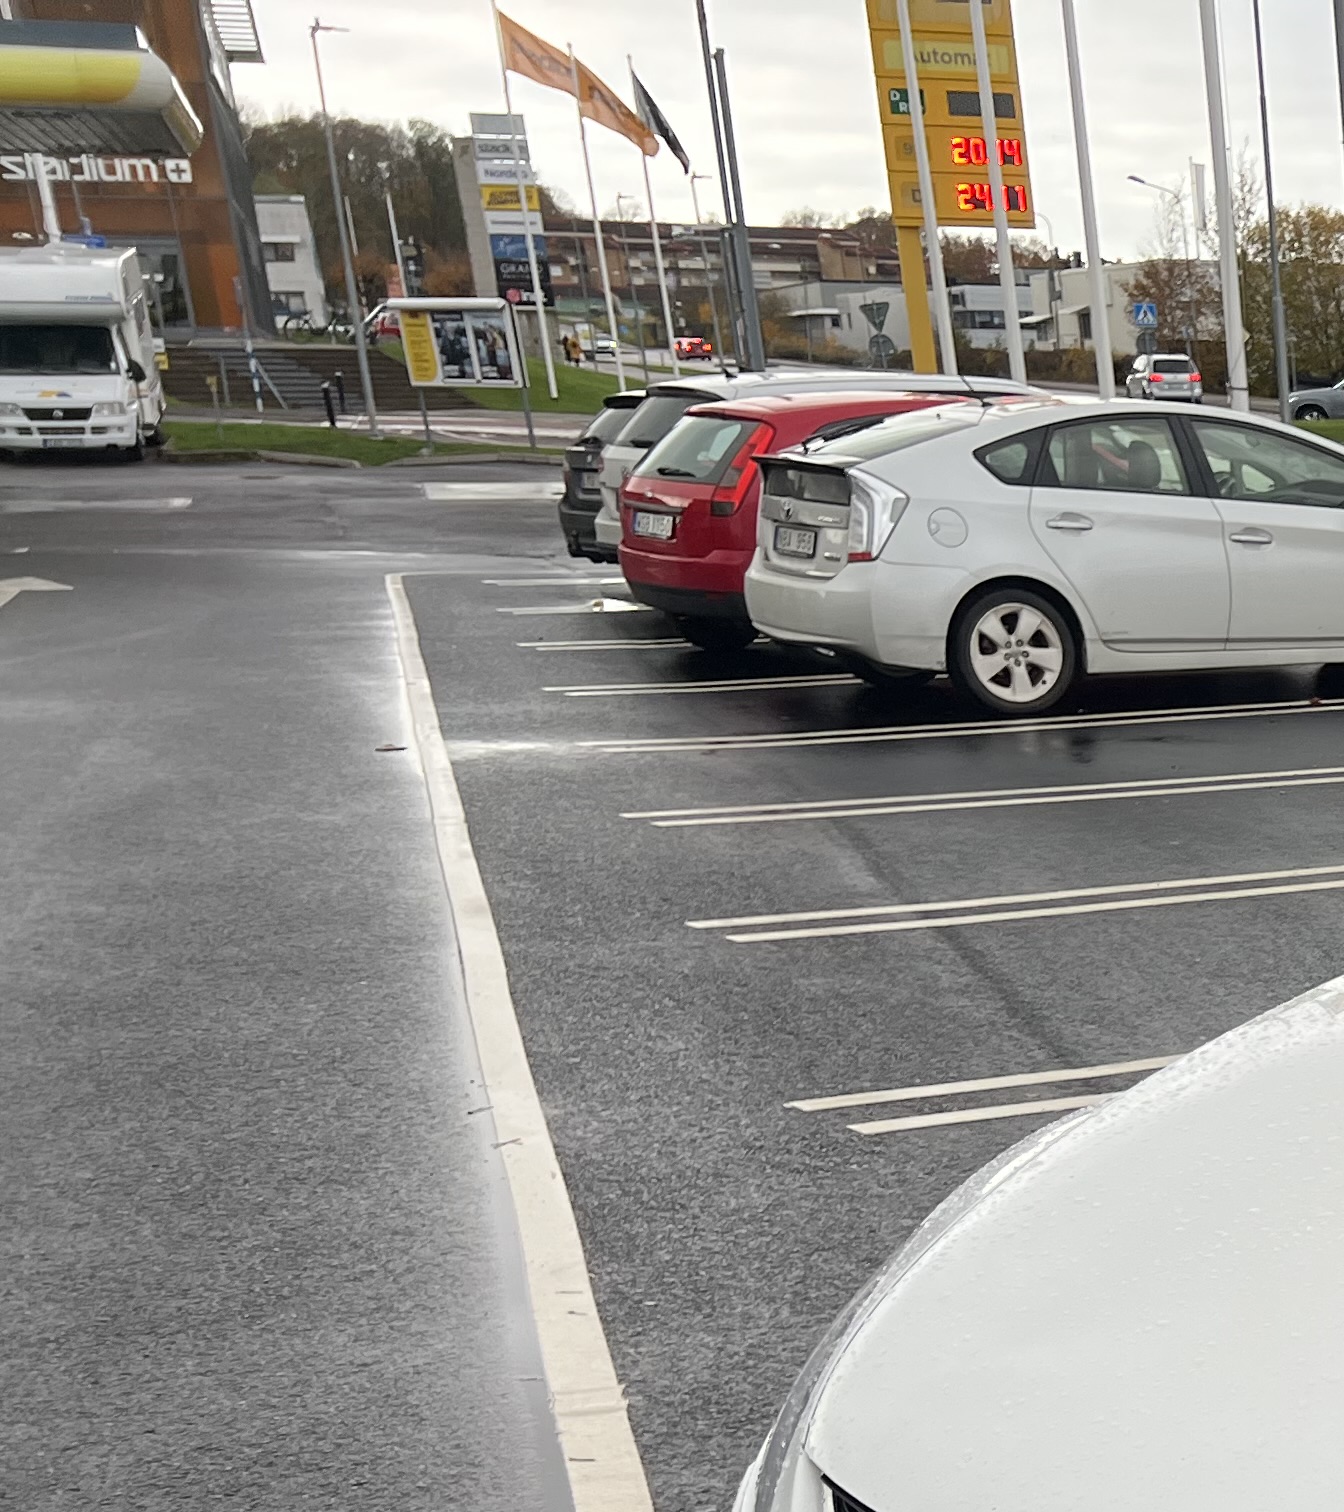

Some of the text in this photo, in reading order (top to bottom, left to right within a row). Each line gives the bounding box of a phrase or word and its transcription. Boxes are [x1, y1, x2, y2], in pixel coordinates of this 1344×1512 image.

[912, 48, 992, 67] utom
[951, 136, 1022, 166] 20.14
[956, 183, 1027, 212] 24.11
